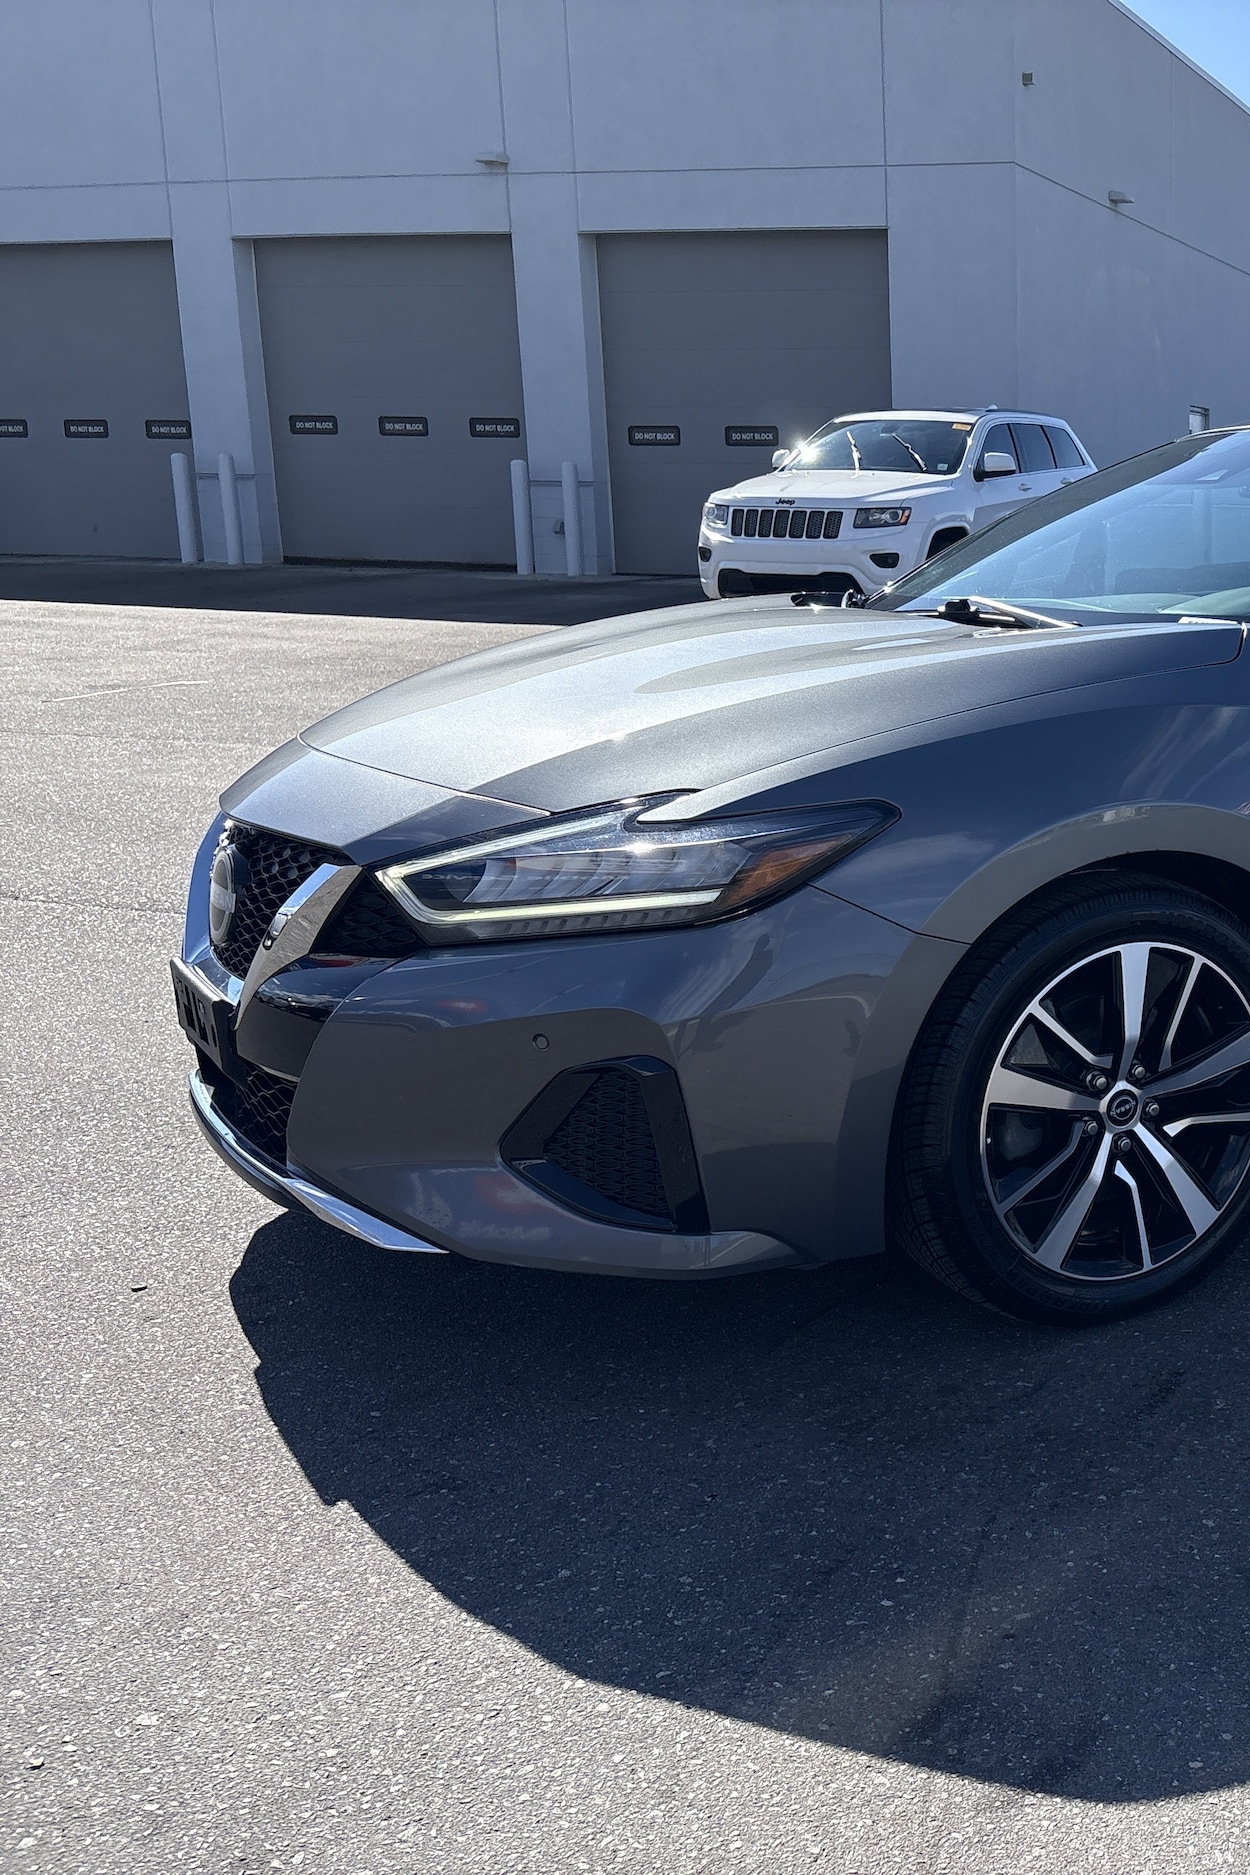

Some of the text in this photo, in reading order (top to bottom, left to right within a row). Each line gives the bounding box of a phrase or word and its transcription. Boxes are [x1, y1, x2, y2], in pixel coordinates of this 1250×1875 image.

[296, 421, 333, 429] DO NOT BLOCK
[485, 424, 496, 432] NOT
[497, 424, 515, 432] BLOCK
[170, 426, 187, 434] BLOCK
[775, 498, 796, 506] Jeep
